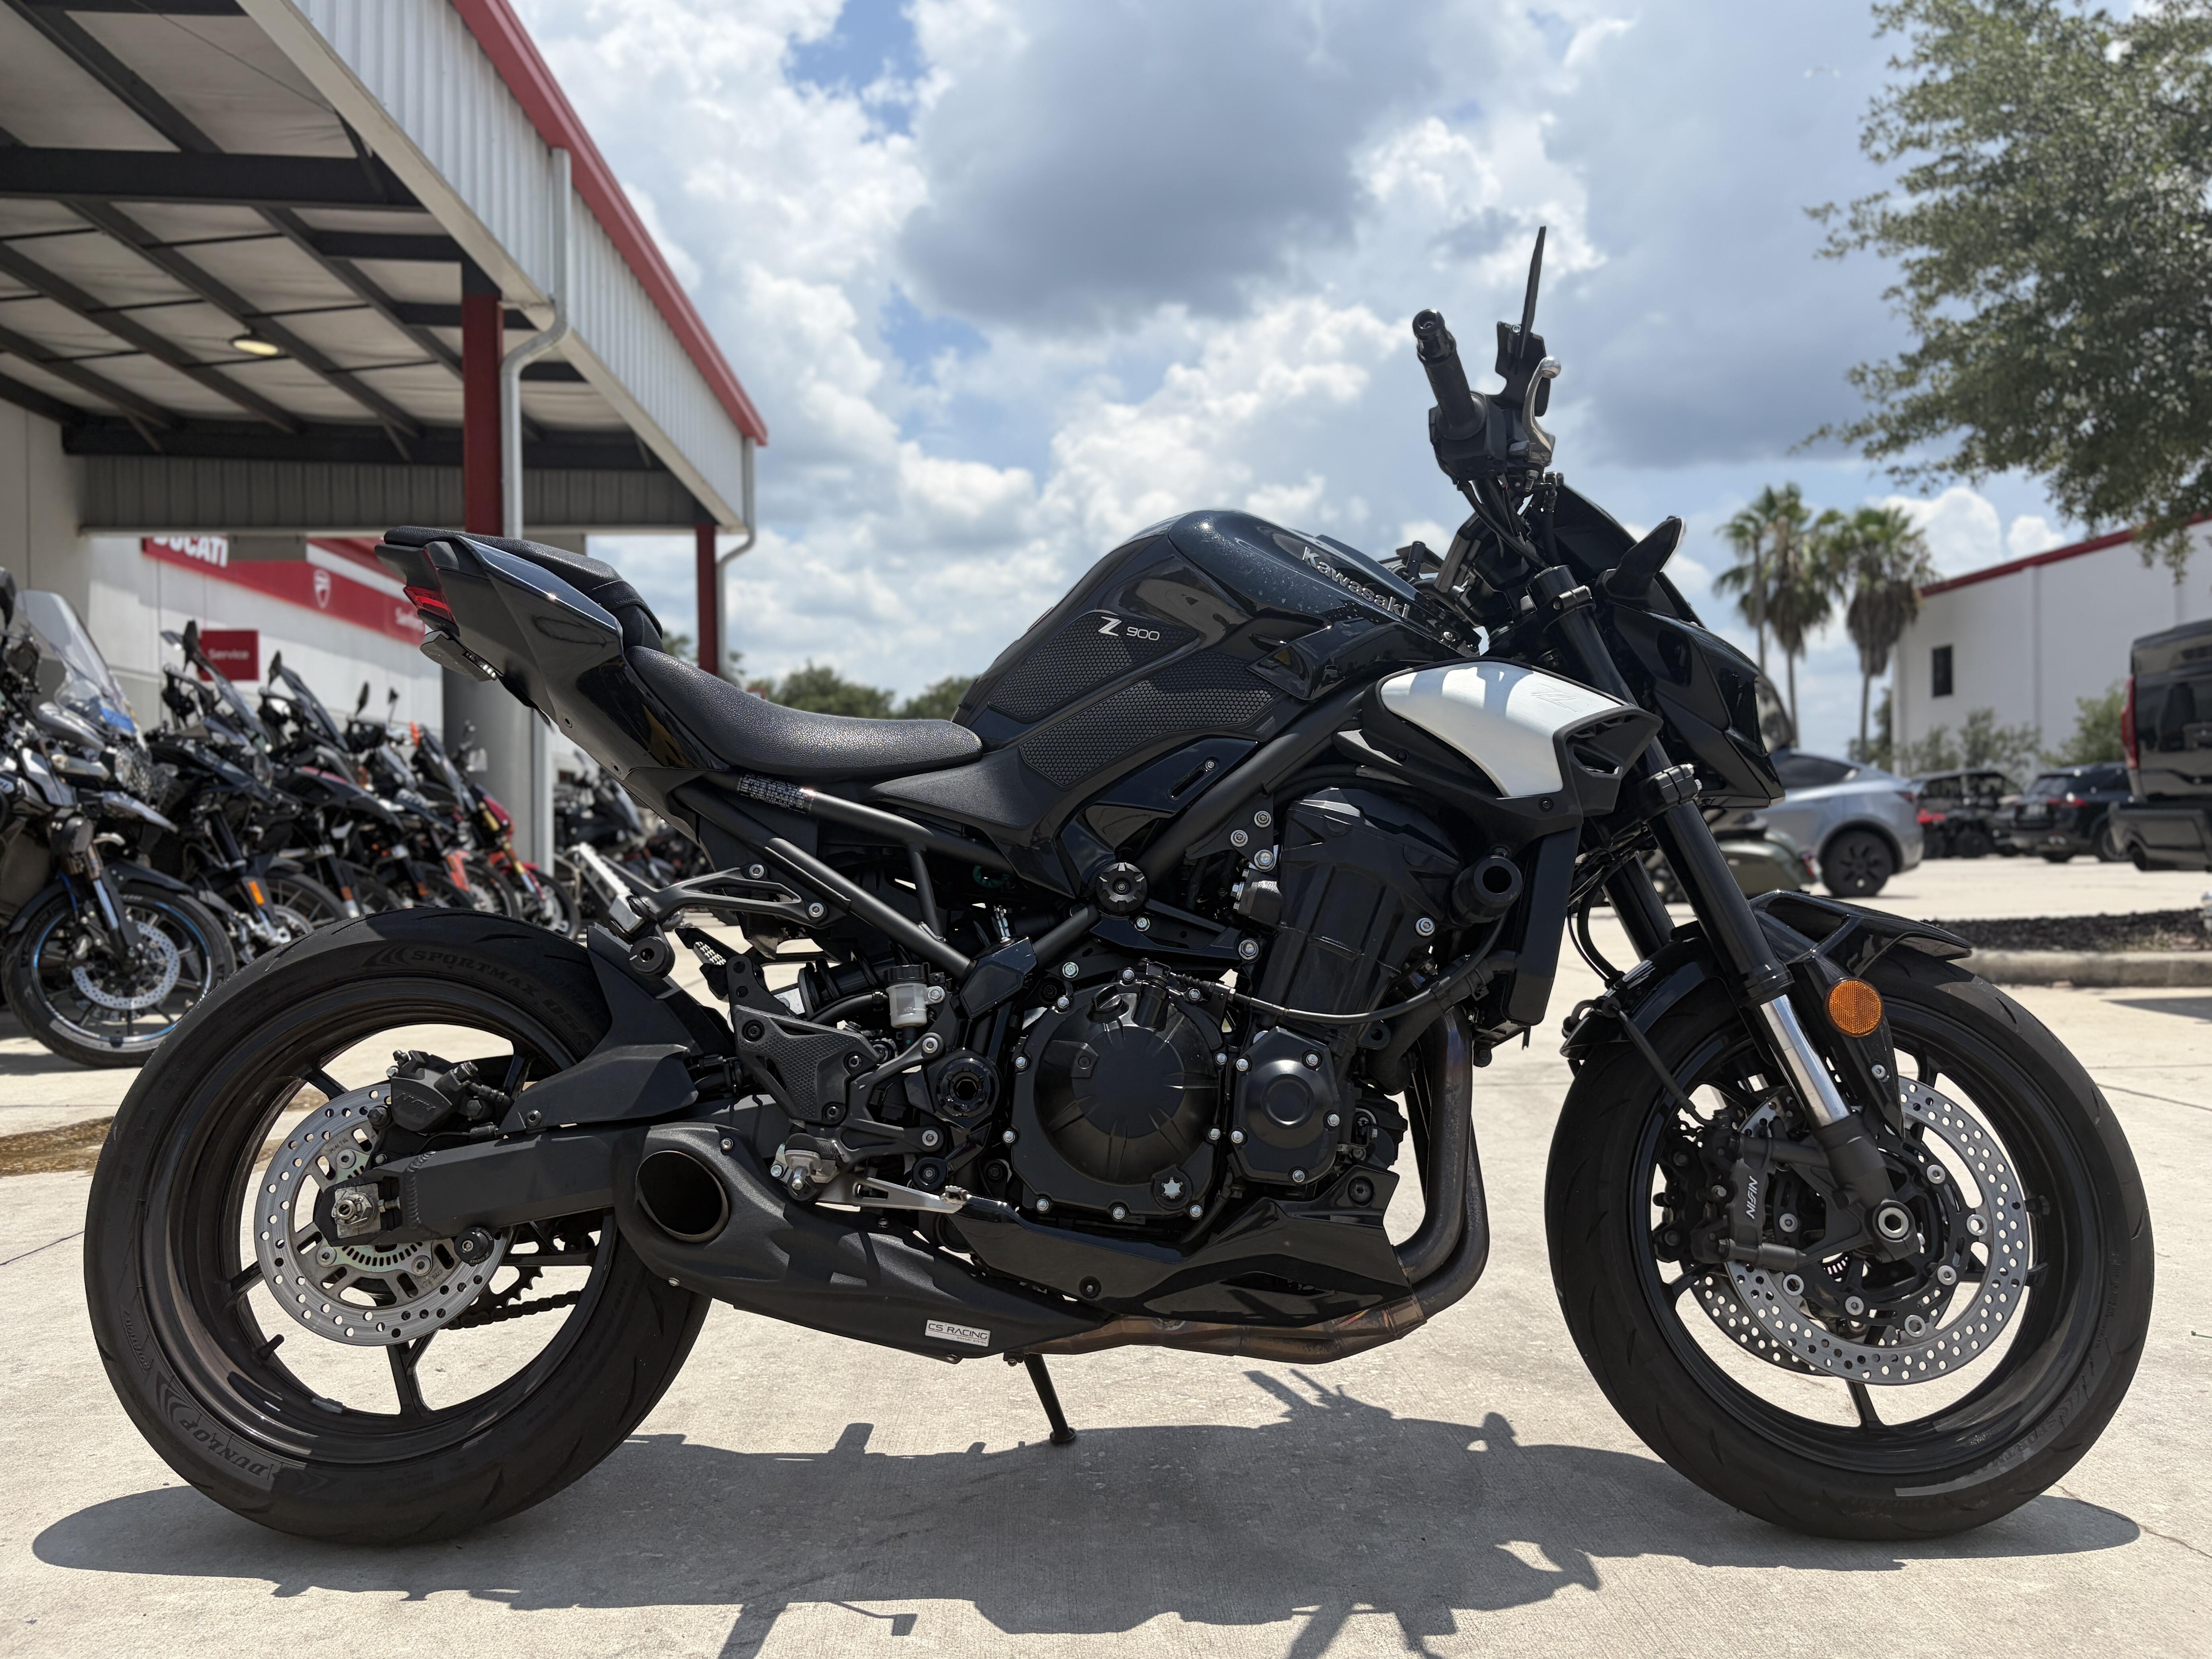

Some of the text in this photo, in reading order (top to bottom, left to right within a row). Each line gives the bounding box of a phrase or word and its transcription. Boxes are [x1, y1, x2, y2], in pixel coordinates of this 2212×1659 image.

[1302, 547, 1410, 619] Kawasaki
[1098, 616, 1160, 641] Z 900
[208, 648, 249, 661] Service
[411, 950, 540, 997] SPORTMAX
[947, 1326, 988, 1339] RACING
[179, 1419, 269, 1475] DUNLOP
